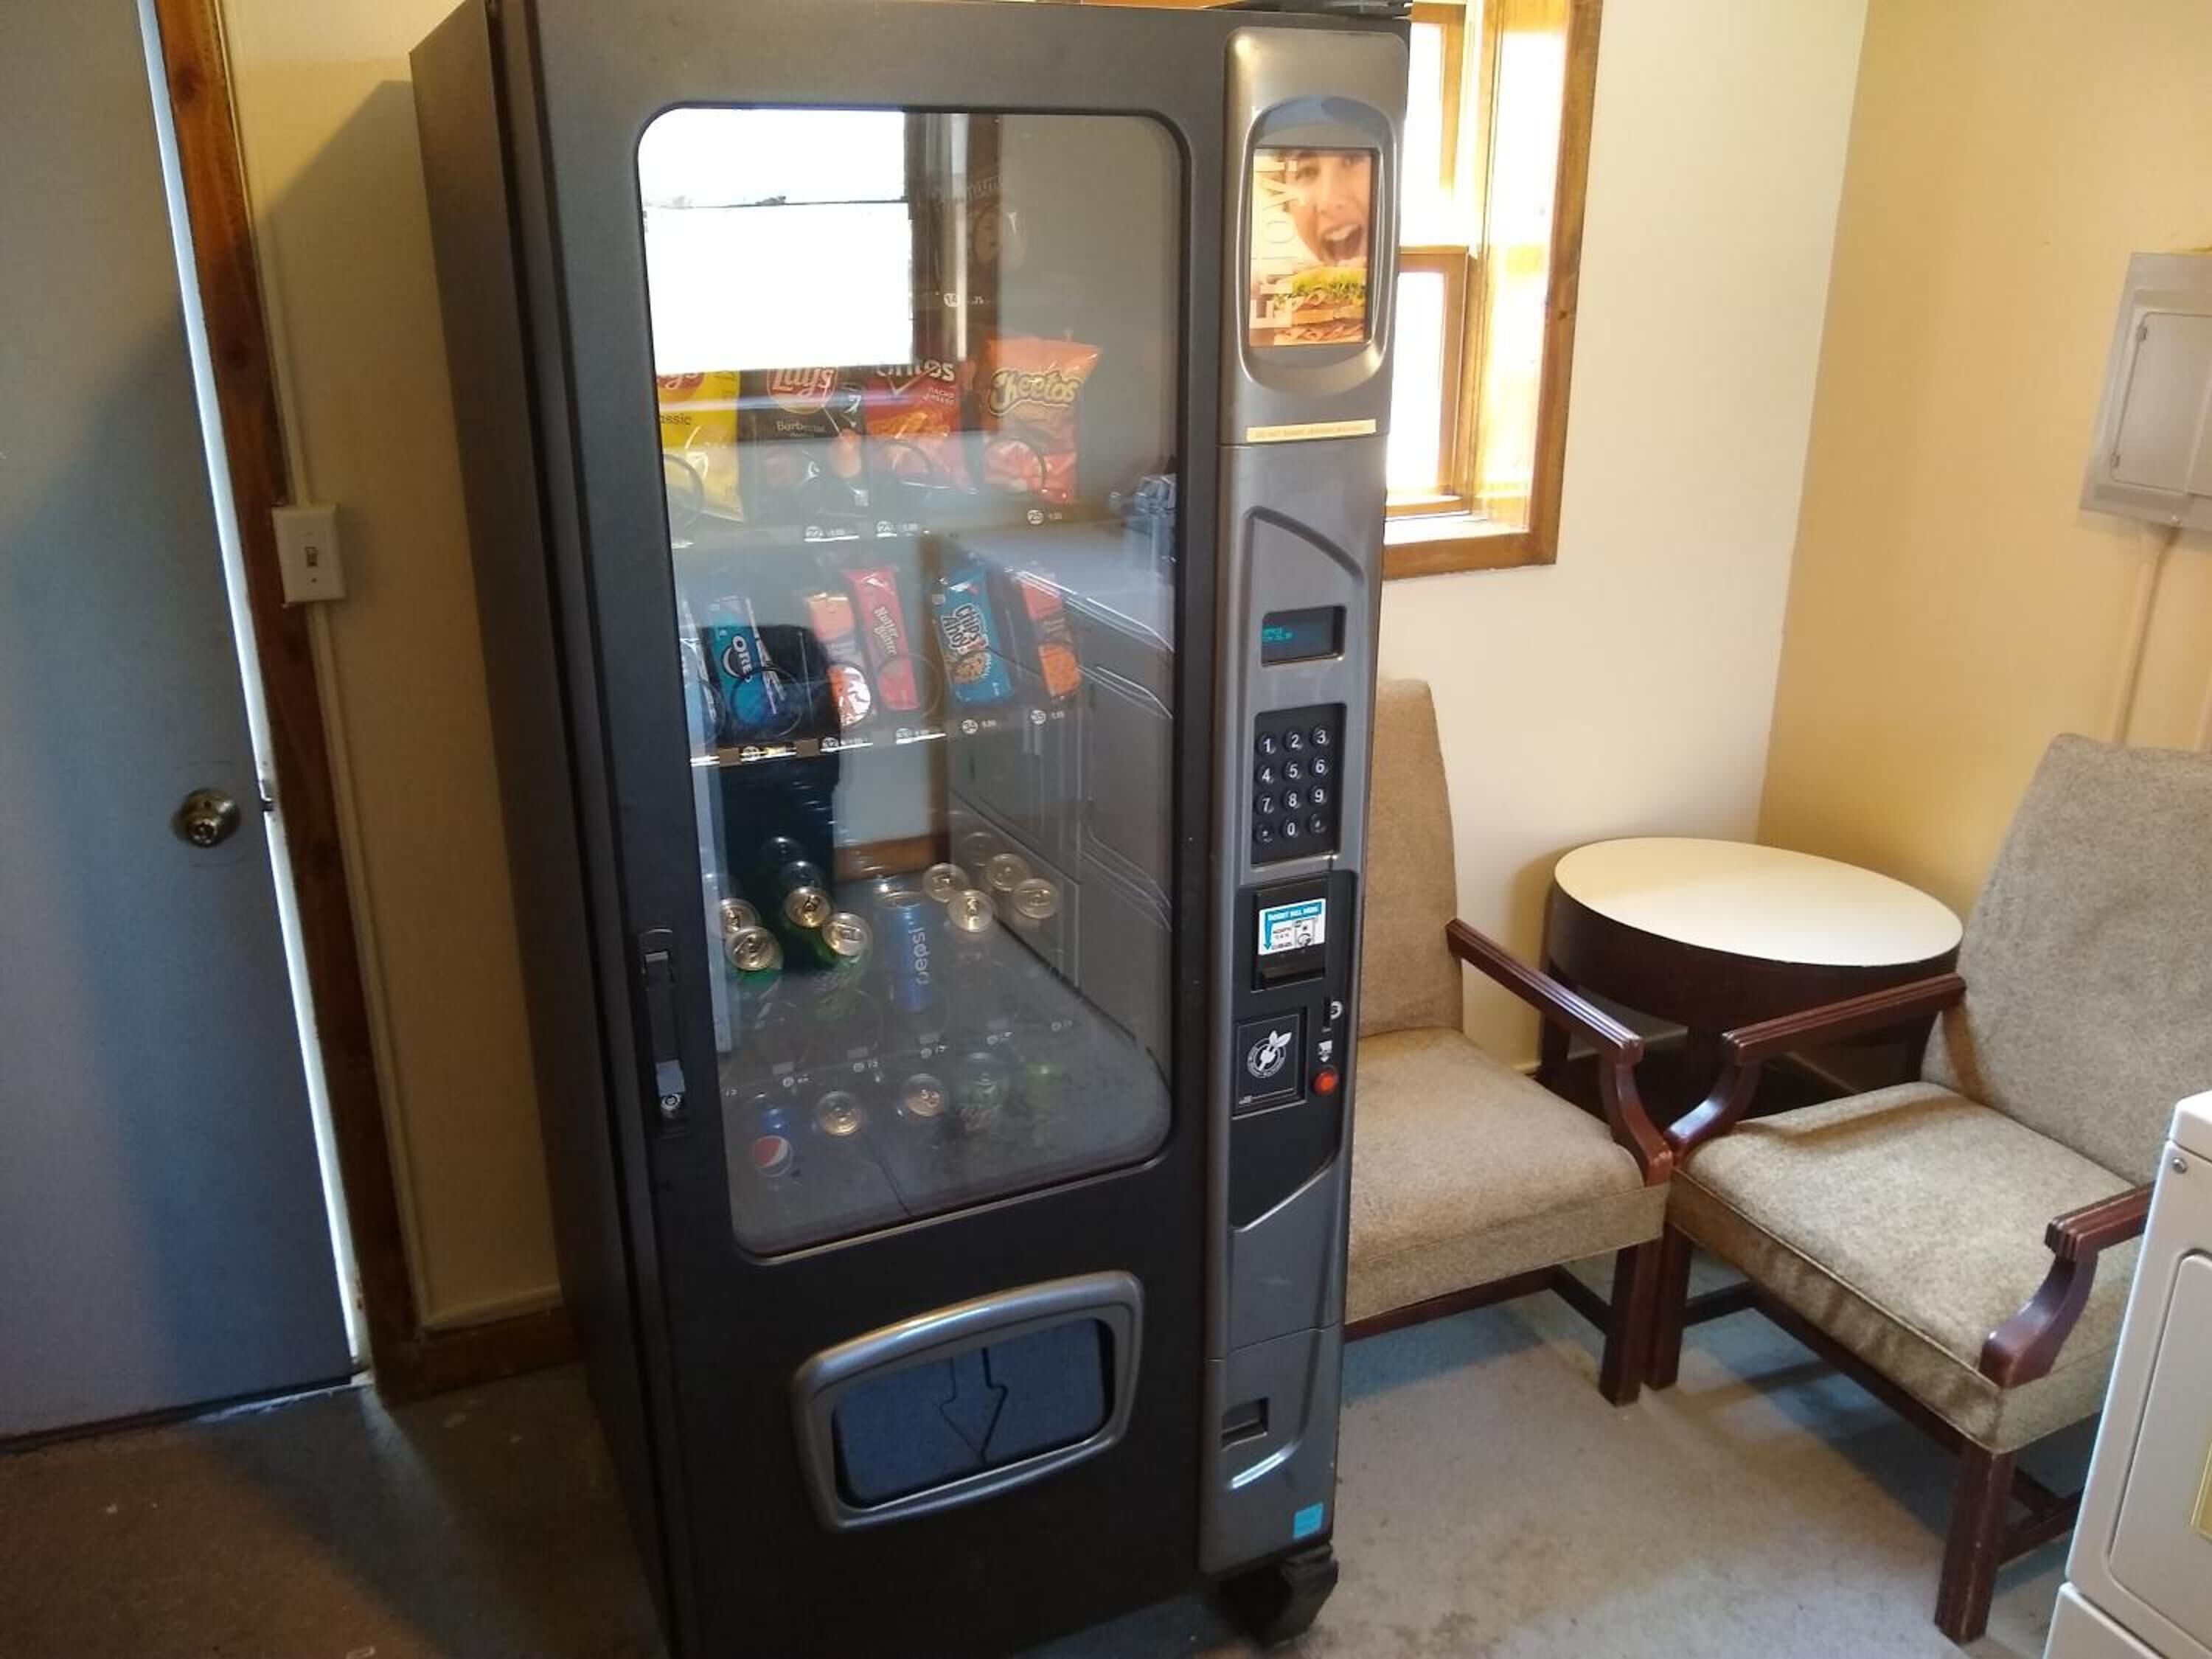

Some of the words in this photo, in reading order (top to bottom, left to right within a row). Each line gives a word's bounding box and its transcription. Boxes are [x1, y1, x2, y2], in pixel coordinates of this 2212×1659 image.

[989, 369, 1080, 417] Cheetos
[661, 413, 692, 425] assic
[1264, 738, 1271, 752] 1
[1291, 734, 1300, 748] 2
[1317, 730, 1326, 744] 3
[1262, 768, 1270, 780] 4
[1289, 764, 1298, 778] 5
[1315, 760, 1325, 773] 6
[1262, 799, 1270, 812] 7
[1289, 793, 1297, 807] 8
[1315, 789, 1324, 802] 9
[1287, 822, 1295, 836] 0
